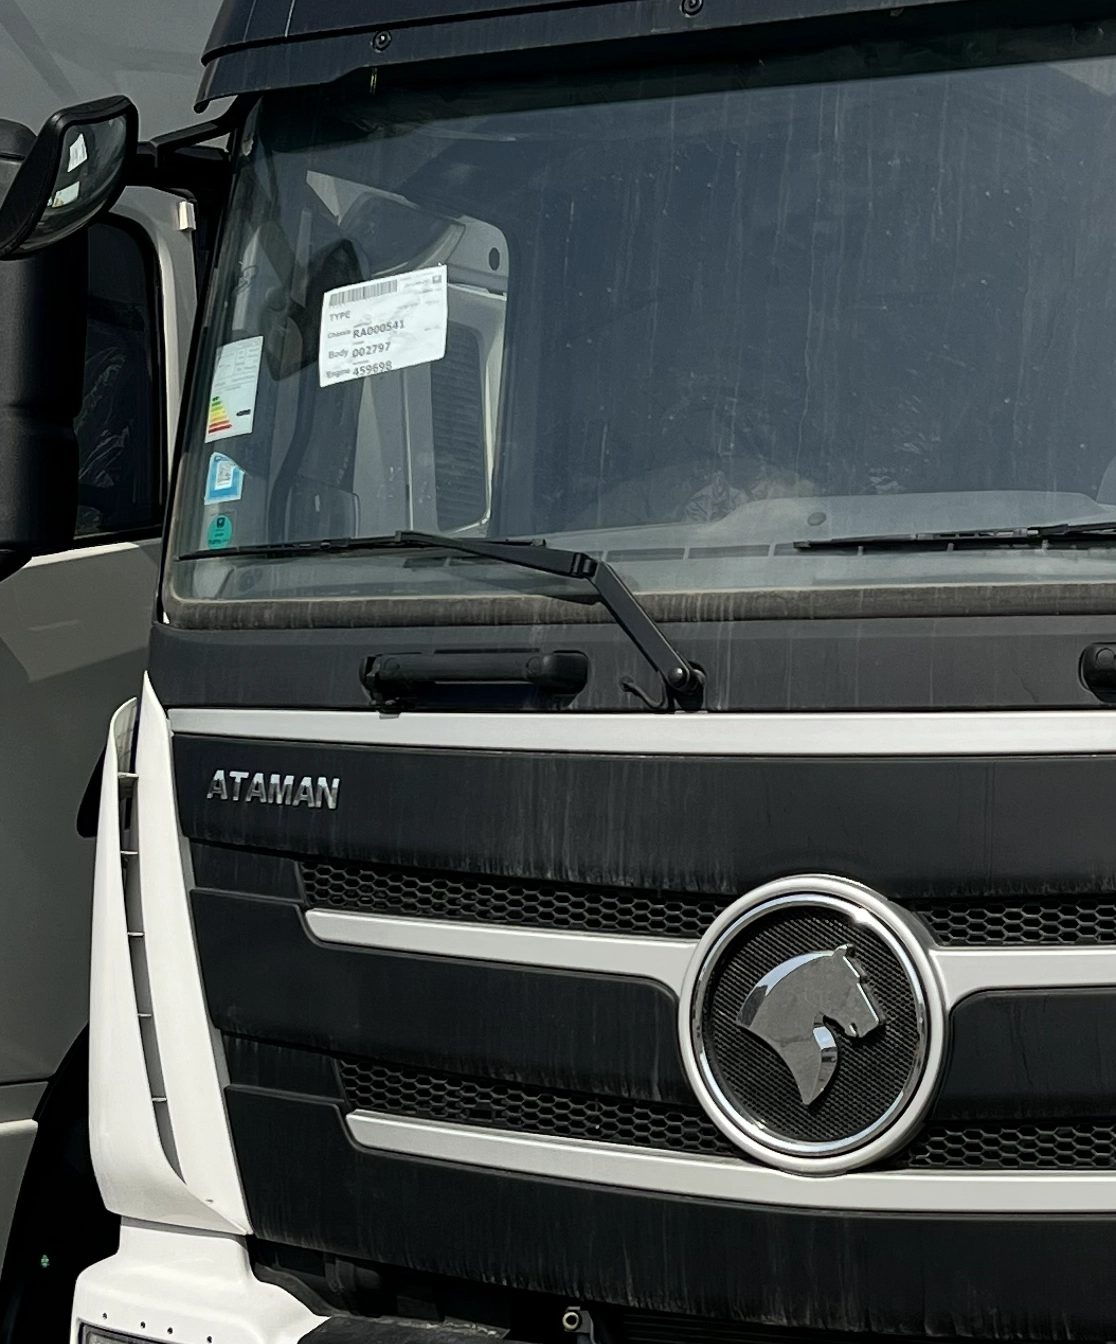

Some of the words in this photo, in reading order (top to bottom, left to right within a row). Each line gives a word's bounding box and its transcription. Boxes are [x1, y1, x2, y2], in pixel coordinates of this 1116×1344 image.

[329, 310, 351, 322] TYPE
[352, 341, 392, 358] 002797
[206, 769, 341, 810] ATAMAN
